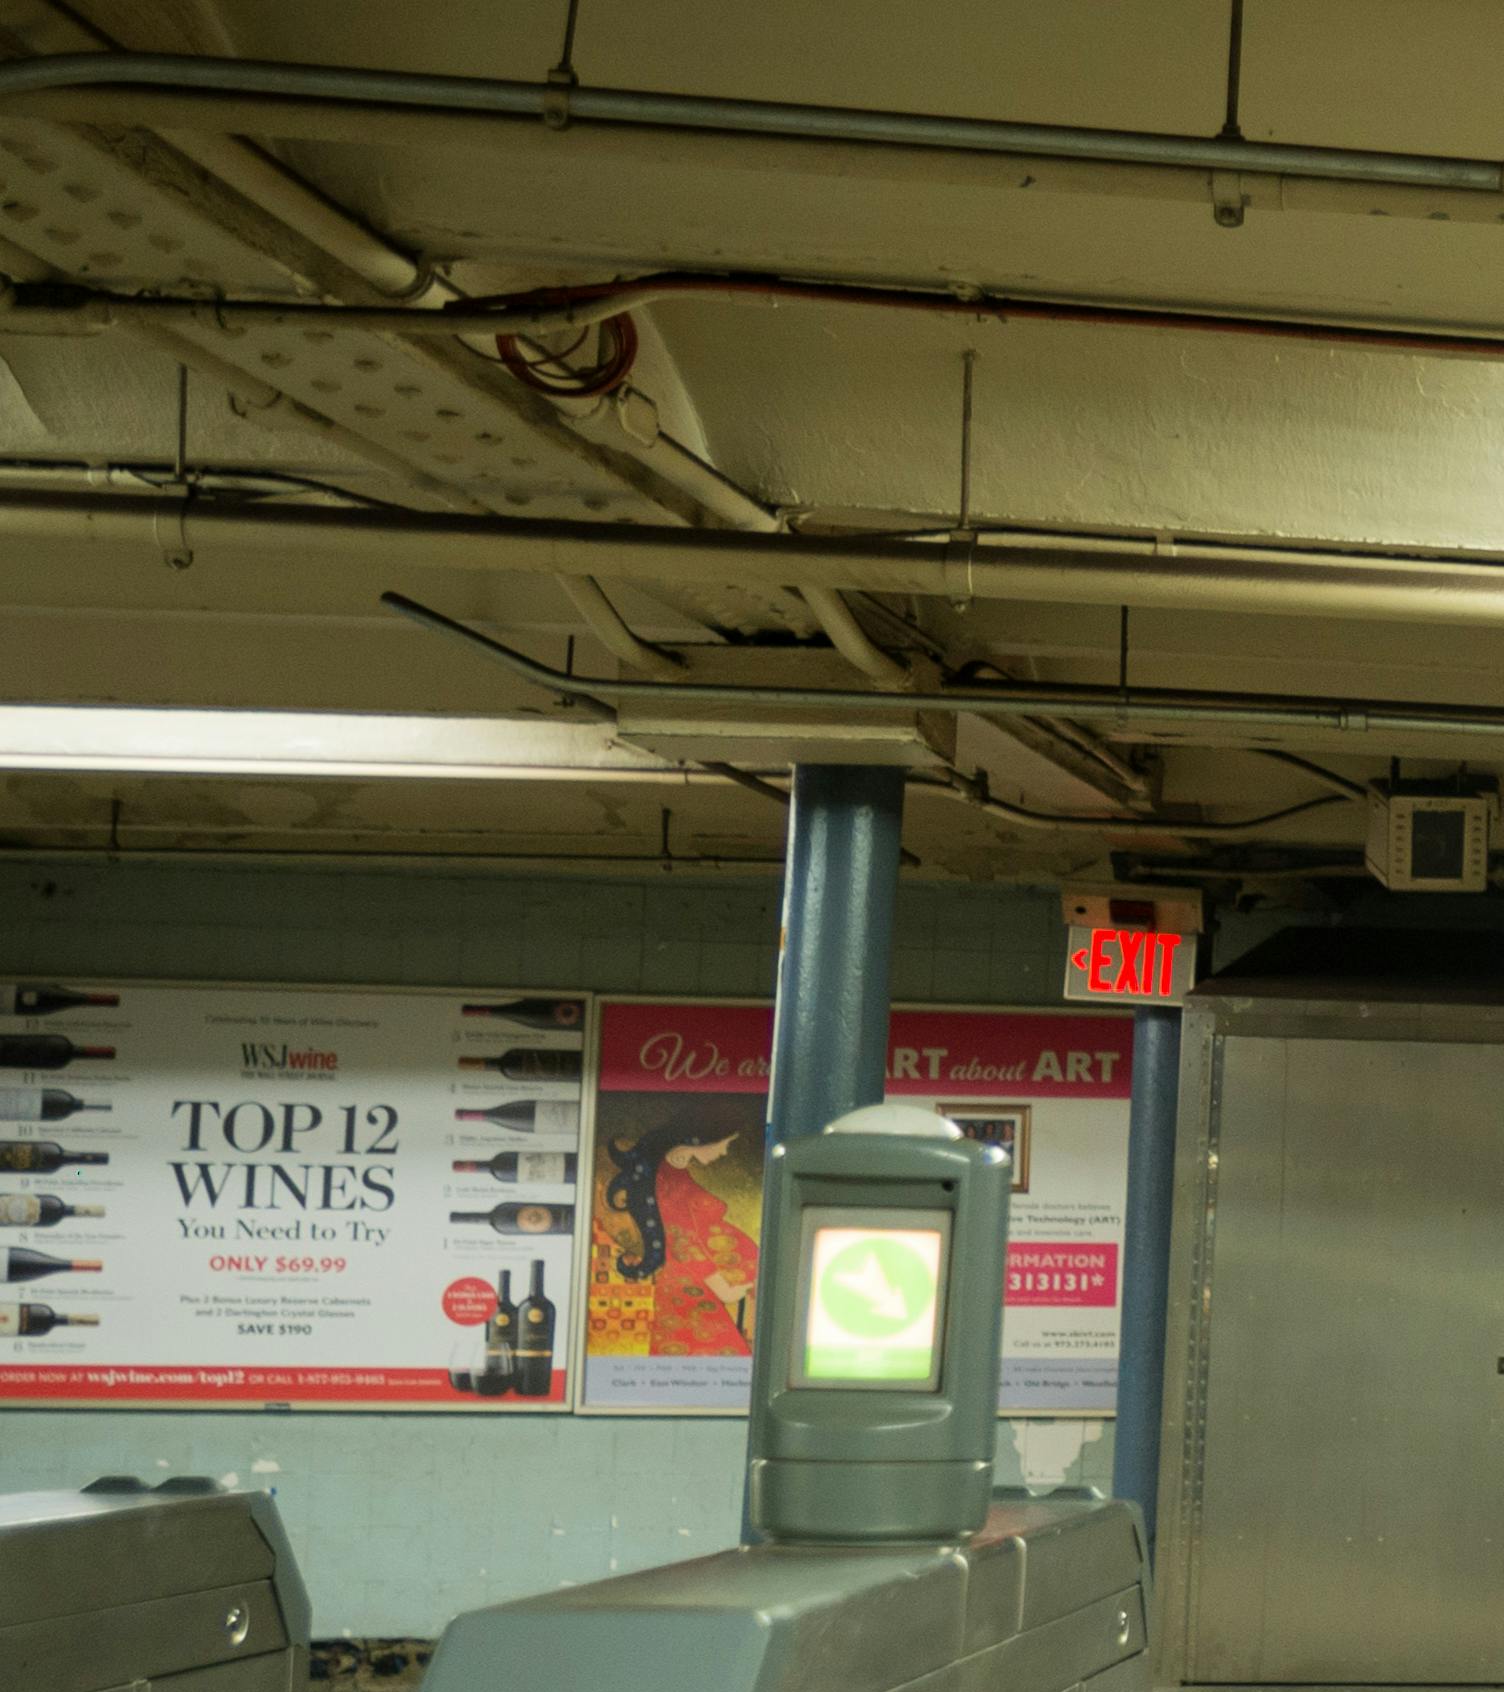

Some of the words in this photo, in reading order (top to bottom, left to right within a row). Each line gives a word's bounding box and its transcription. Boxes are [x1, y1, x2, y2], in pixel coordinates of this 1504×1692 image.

[1087, 928, 1183, 997] EXIT
[241, 1043, 338, 1071] WSJwine
[639, 1031, 730, 1082] We
[950, 1057, 1028, 1082] about
[1031, 1050, 1121, 1083] ART
[170, 1100, 323, 1154] TOP
[336, 1103, 399, 1156] 12
[167, 1161, 396, 1212] WINES
[177, 1217, 225, 1240] You
[235, 1218, 301, 1242] Need
[311, 1222, 337, 1243] to
[345, 1220, 391, 1248] Try
[209, 1254, 268, 1273] ONLY
[275, 1255, 348, 1274] $69.99
[237, 1323, 275, 1335] SAVE
[278, 1323, 313, 1336] $190
